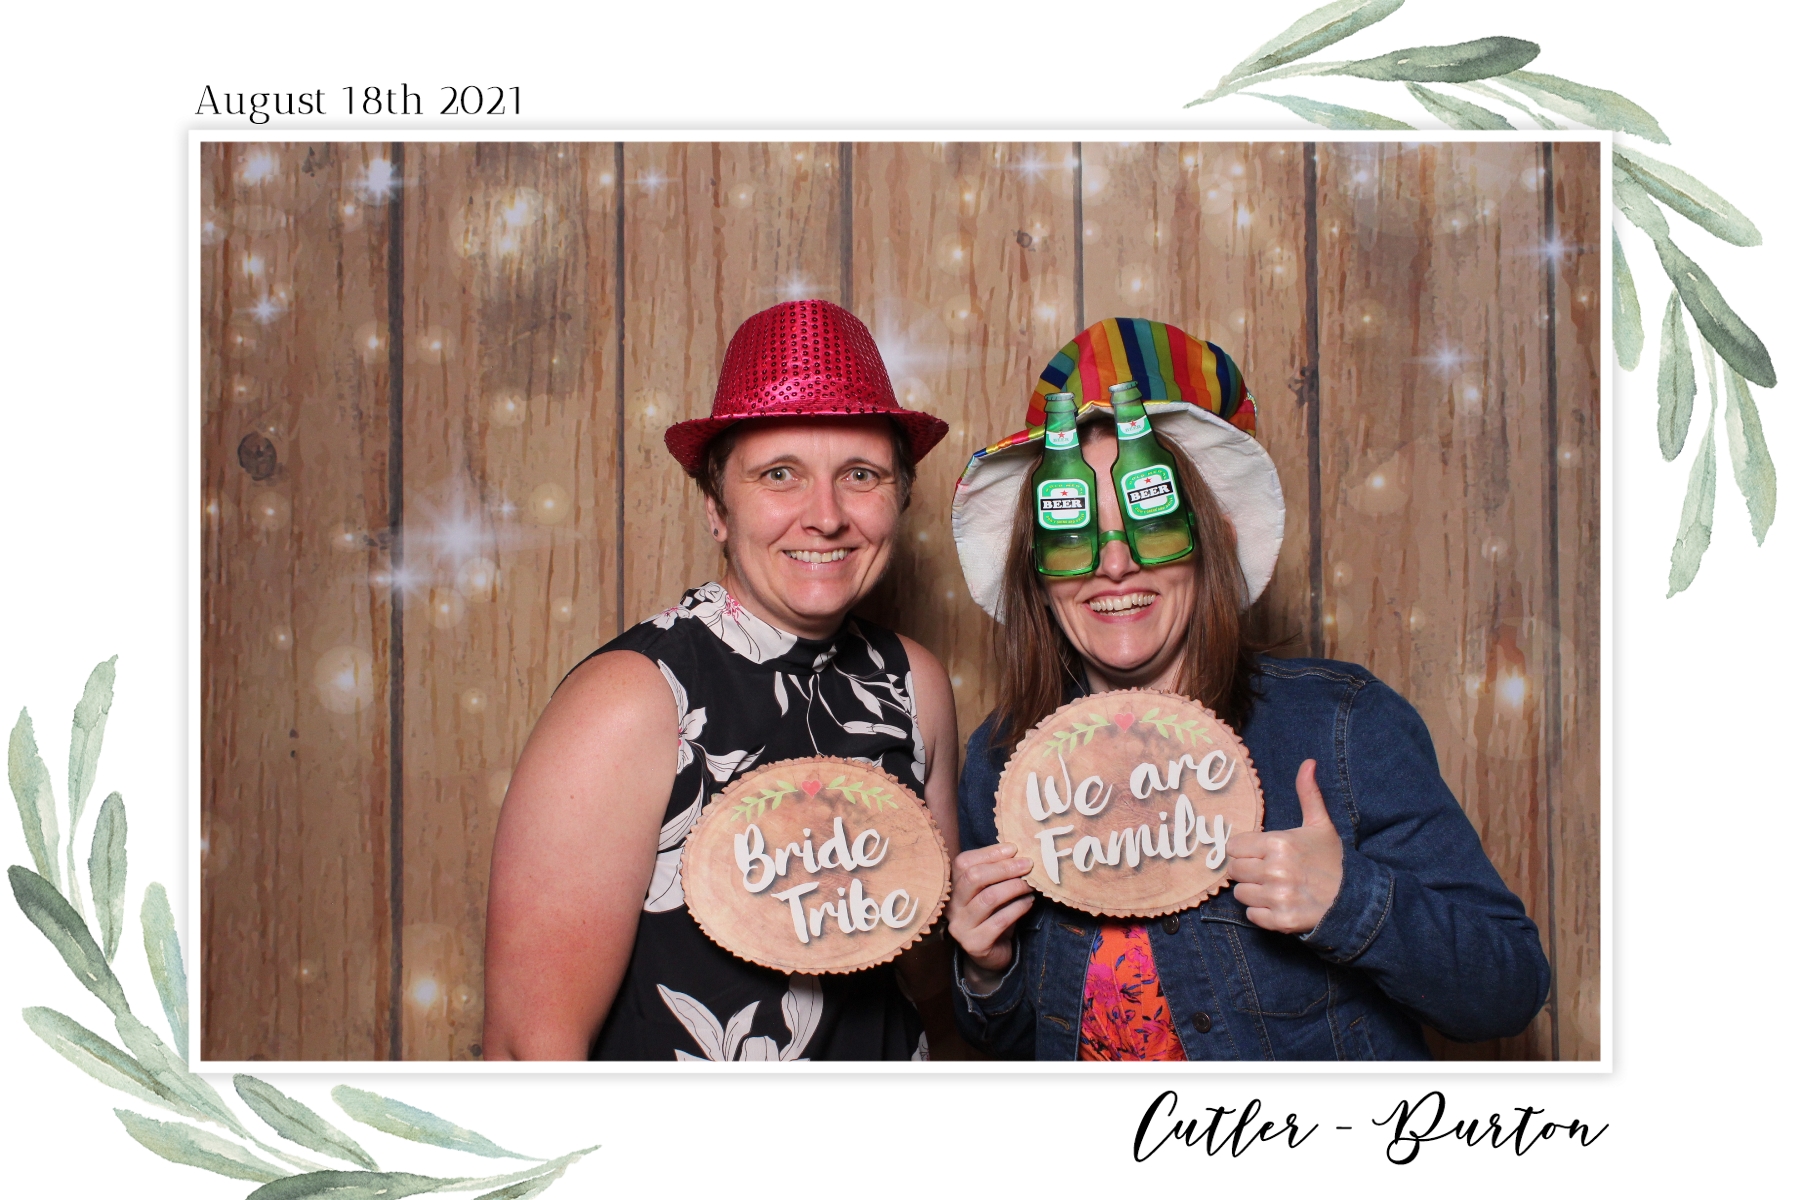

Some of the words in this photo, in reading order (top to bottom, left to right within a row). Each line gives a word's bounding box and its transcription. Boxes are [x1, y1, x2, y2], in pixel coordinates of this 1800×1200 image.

[1042, 499, 1082, 509] BEER
[1130, 484, 1170, 502] BEER
[1026, 752, 1114, 821] We
[1129, 749, 1236, 799] are
[733, 817, 889, 892] Bride
[1035, 794, 1232, 884] Family
[770, 879, 919, 943] Tribe
